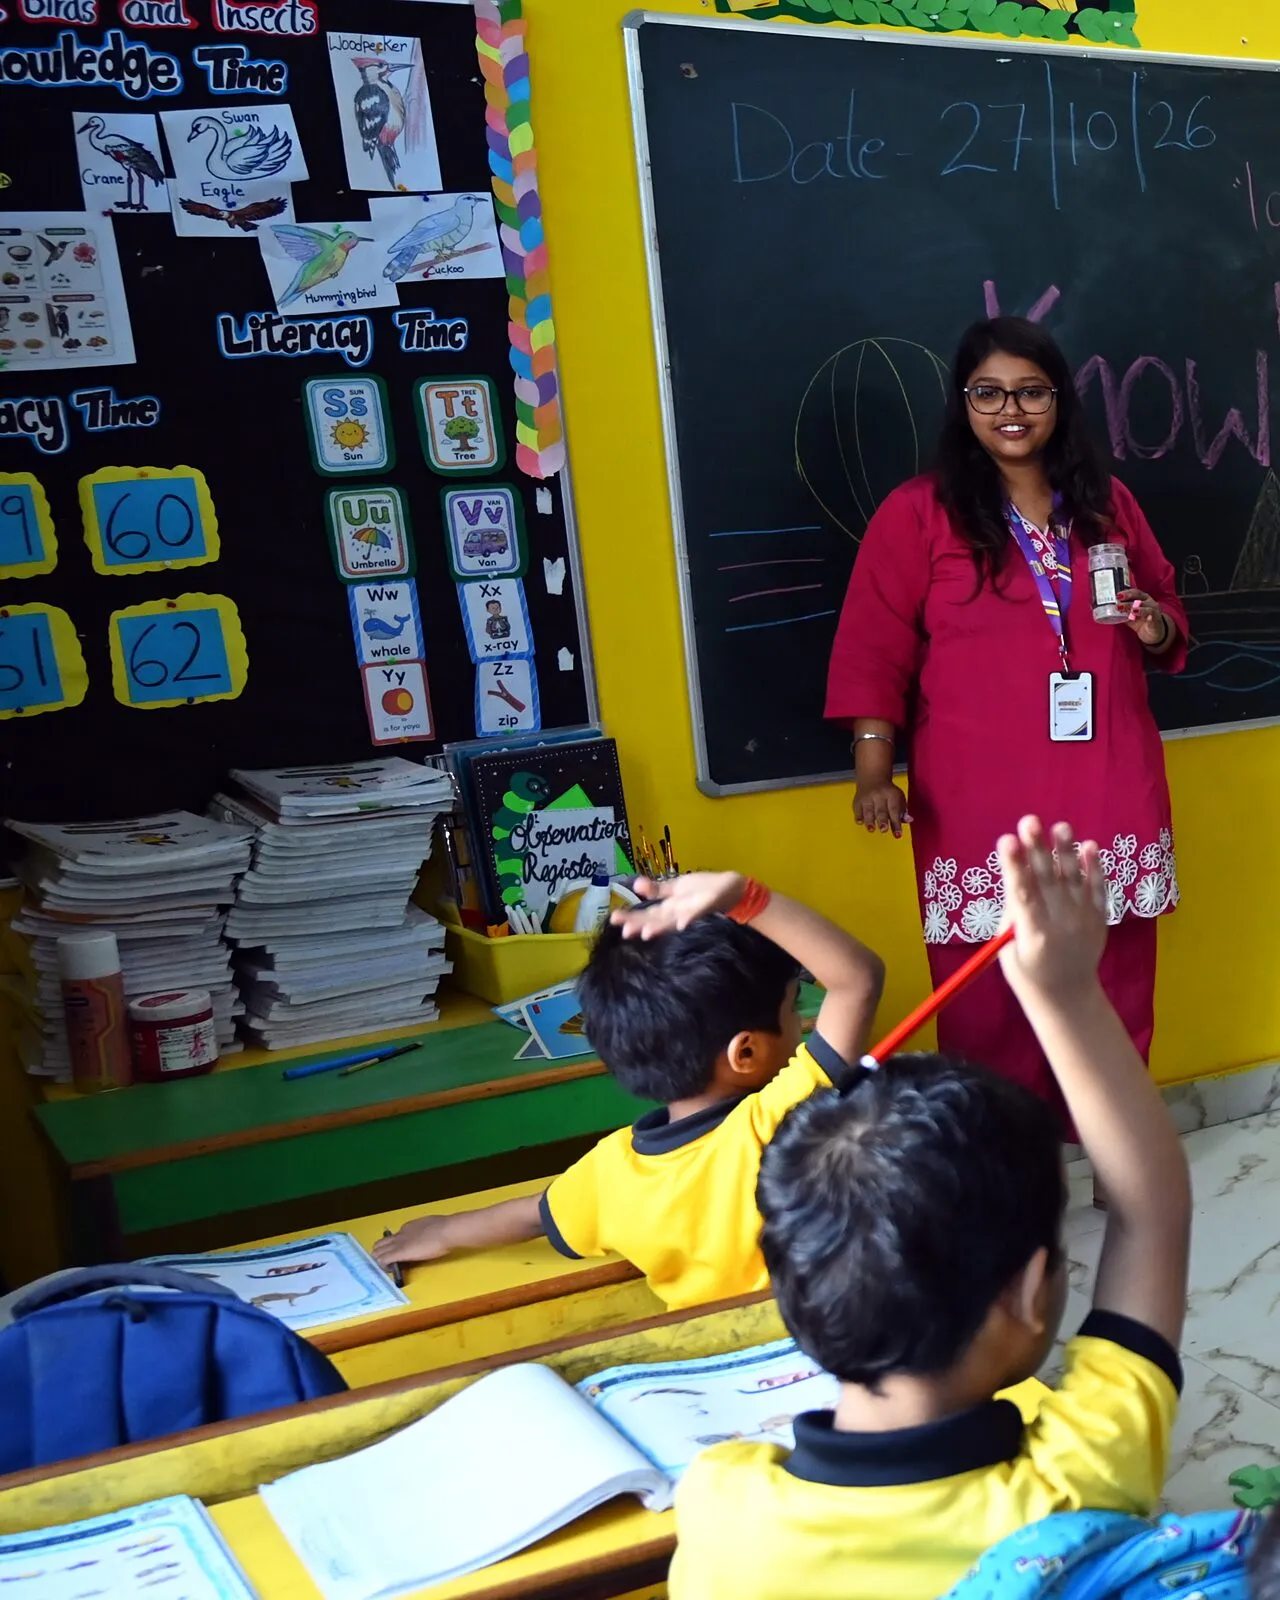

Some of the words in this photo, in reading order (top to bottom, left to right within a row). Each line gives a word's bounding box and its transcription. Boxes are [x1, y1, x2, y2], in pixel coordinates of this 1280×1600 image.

[125, 0, 190, 25] and
[217, 0, 316, 34] Insects
[328, 34, 408, 55] Woodpecker
[0, 32, 178, 98] owledge
[198, 48, 285, 91] Time
[222, 111, 259, 125] Swan
[82, 169, 125, 186] Crane
[200, 182, 245, 203] Eagle
[427, 264, 465, 276] Cuckoo
[305, 284, 378, 304] Hummingbird
[220, 312, 370, 362] Literacy
[398, 312, 467, 350] Time
[76, 389, 158, 428] Time
[323, 388, 368, 418] Ss
[435, 390, 478, 418] Tt
[343, 452, 364, 461] Sun
[453, 452, 476, 461] Tree
[342, 498, 391, 527] Uu
[457, 499, 503, 526] Vv
[106, 493, 194, 559] 60
[351, 558, 397, 571] Umbrella
[478, 559, 497, 568] Van
[367, 587, 399, 602] Ww
[479, 584, 503, 598] Xx
[371, 645, 411, 658] whale
[484, 639, 519, 652] x-ray
[130, 622, 221, 687] 62
[382, 669, 406, 686] Yy
[493, 663, 514, 676] Zz
[498, 715, 519, 727] zip
